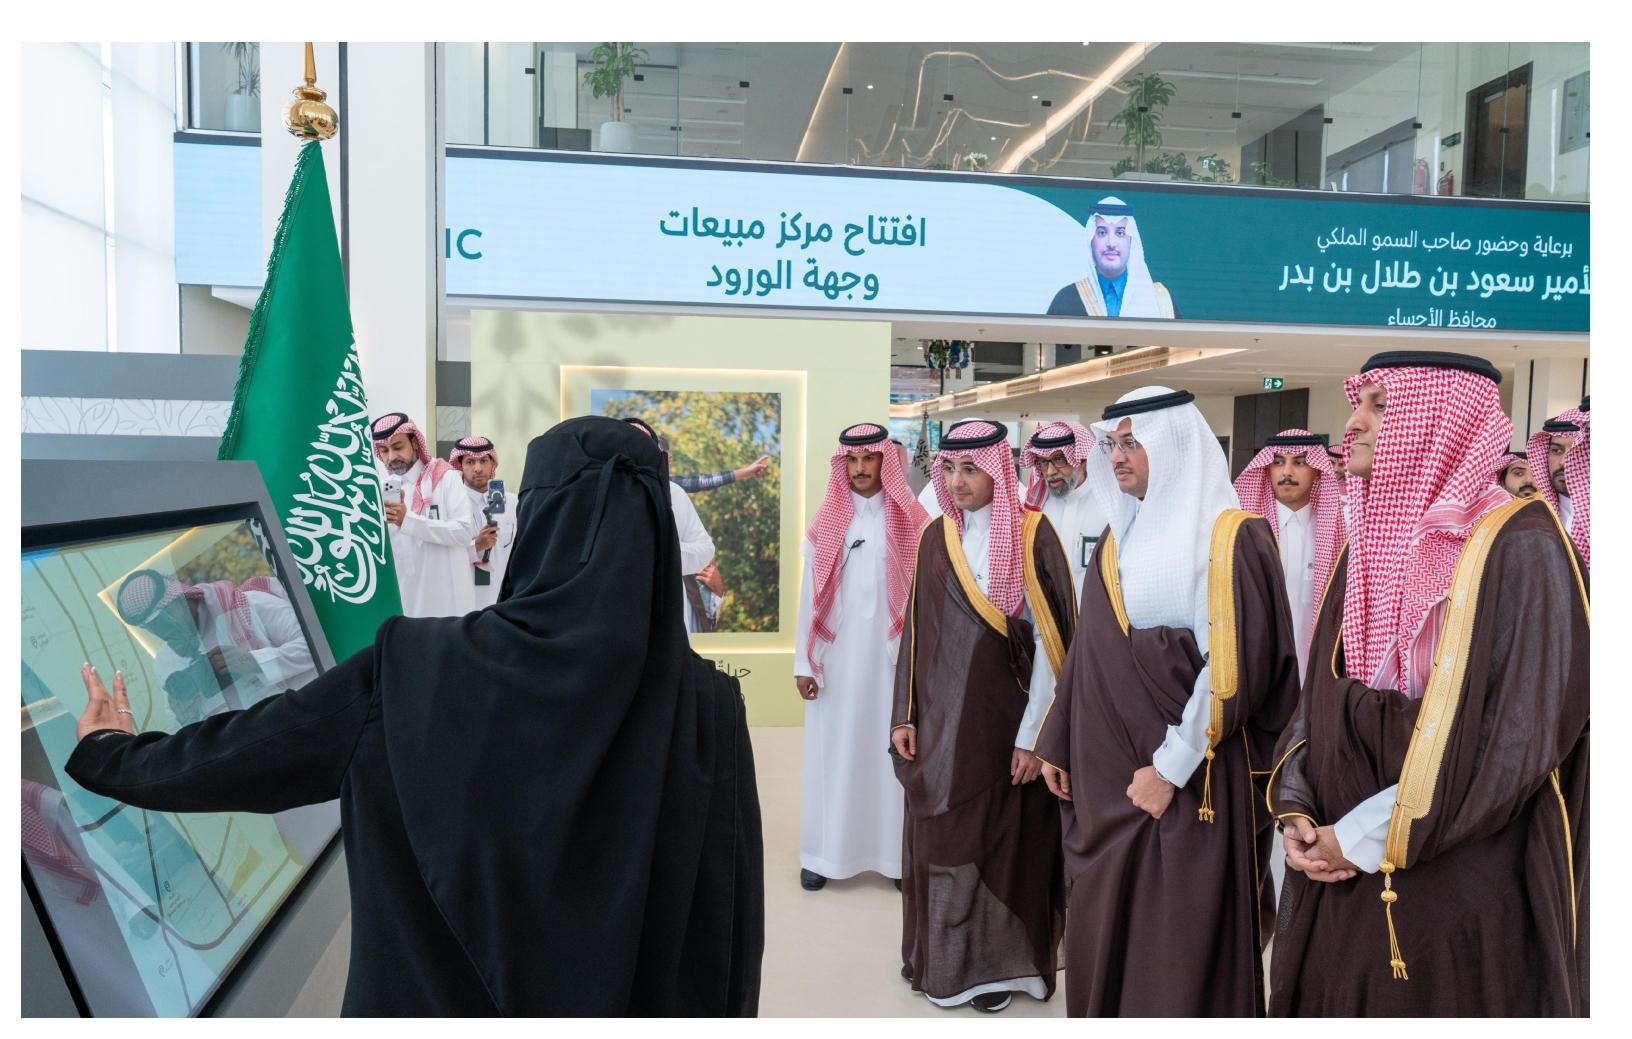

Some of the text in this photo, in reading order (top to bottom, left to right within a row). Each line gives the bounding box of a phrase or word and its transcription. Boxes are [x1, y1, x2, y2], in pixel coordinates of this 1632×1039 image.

[446, 228, 482, 260] C
[660, 207, 925, 256] افتتاح مركز مبيعات
[1317, 227, 1572, 258] برعاية وحضور صاحب السمو الملكي
[707, 257, 879, 300] وجهة الورود
[1279, 265, 1314, 292] بدر
[1323, 263, 1351, 293] بن
[1361, 260, 1421, 294] طلال
[1430, 267, 1458, 296] بن
[1467, 271, 1534, 298] سعود
[1388, 308, 1496, 328] محافظ الأحساء
